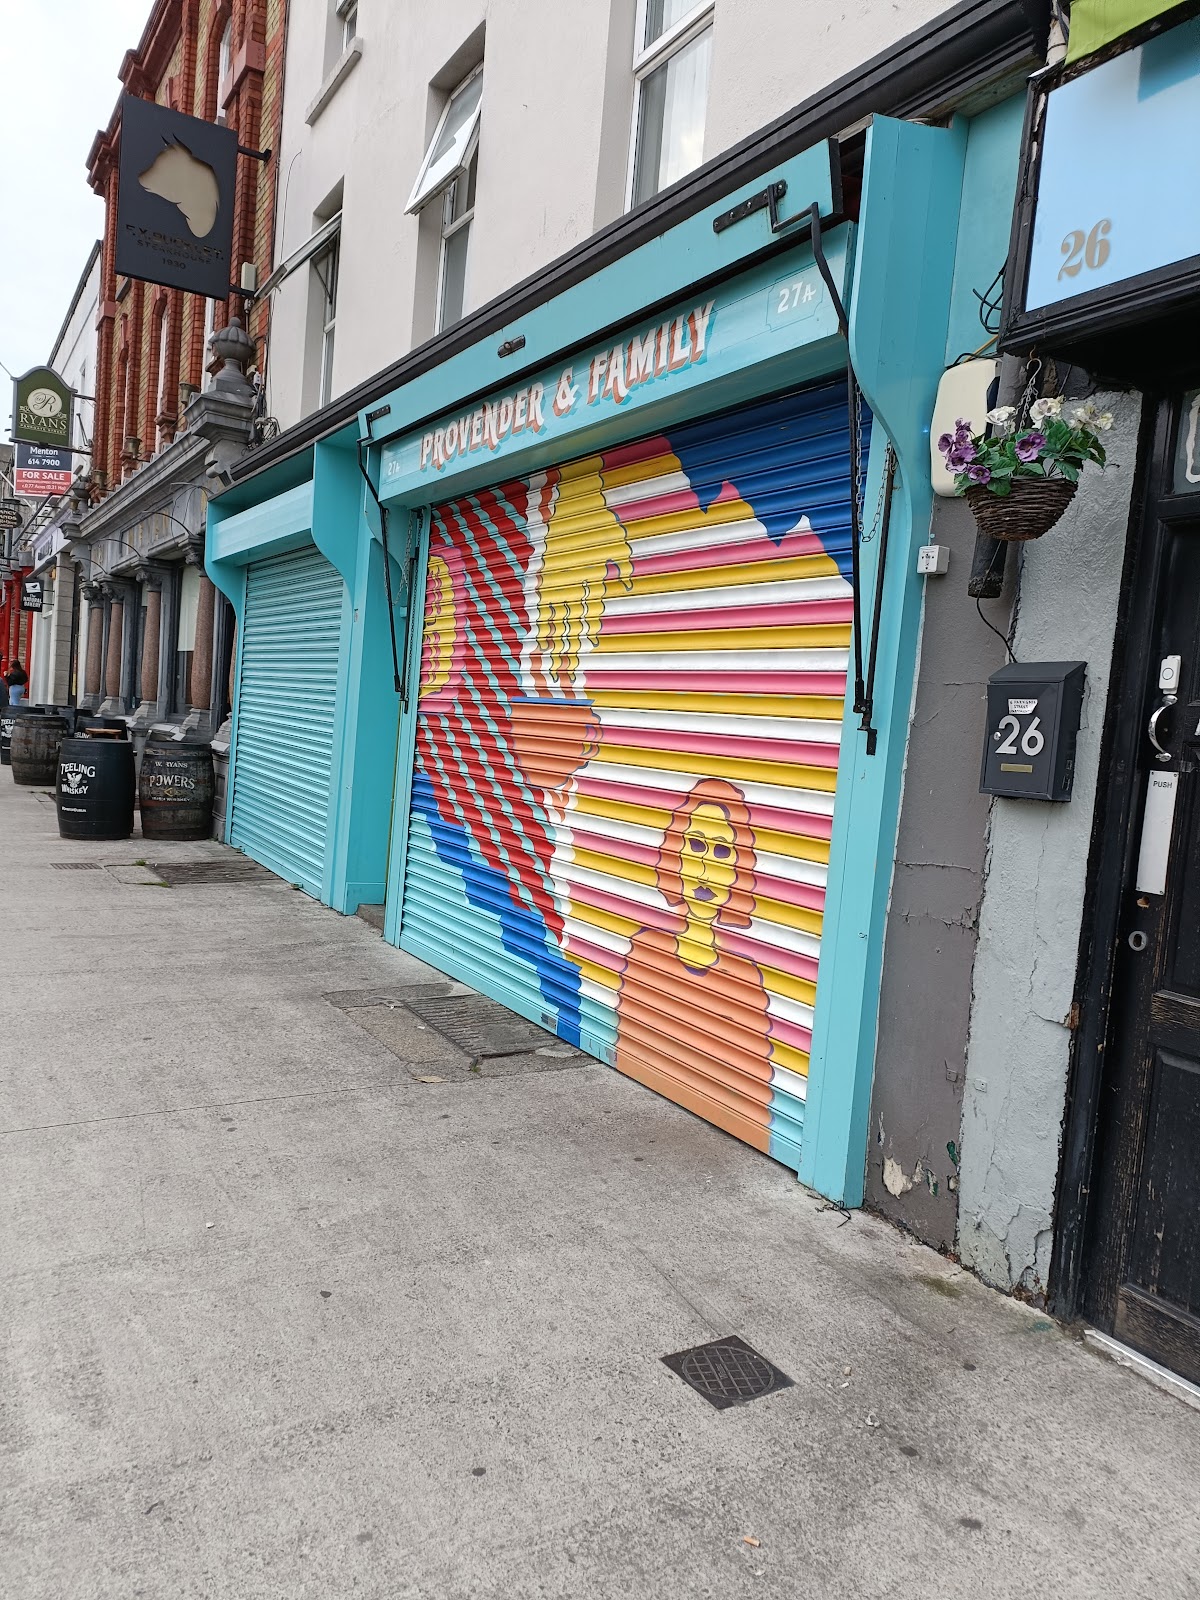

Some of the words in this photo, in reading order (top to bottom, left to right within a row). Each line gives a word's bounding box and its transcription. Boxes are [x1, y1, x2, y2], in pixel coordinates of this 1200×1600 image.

[1057, 219, 1113, 282] 26
[162, 258, 186, 270] 1930
[777, 281, 817, 314] 27A
[420, 382, 545, 471] PROVENDER
[553, 367, 580, 416] &
[587, 300, 716, 405] FAMILY
[20, 413, 67, 430] RYANS
[30, 446, 58, 456] Menton
[22, 471, 40, 479] FOR
[42, 472, 65, 480] SALE
[994, 715, 1045, 756] 26
[61, 763, 96, 778] TEELING
[61, 784, 89, 795] WHISKEY
[149, 775, 196, 790] POWERS
[1153, 780, 1173, 789] PUSH
